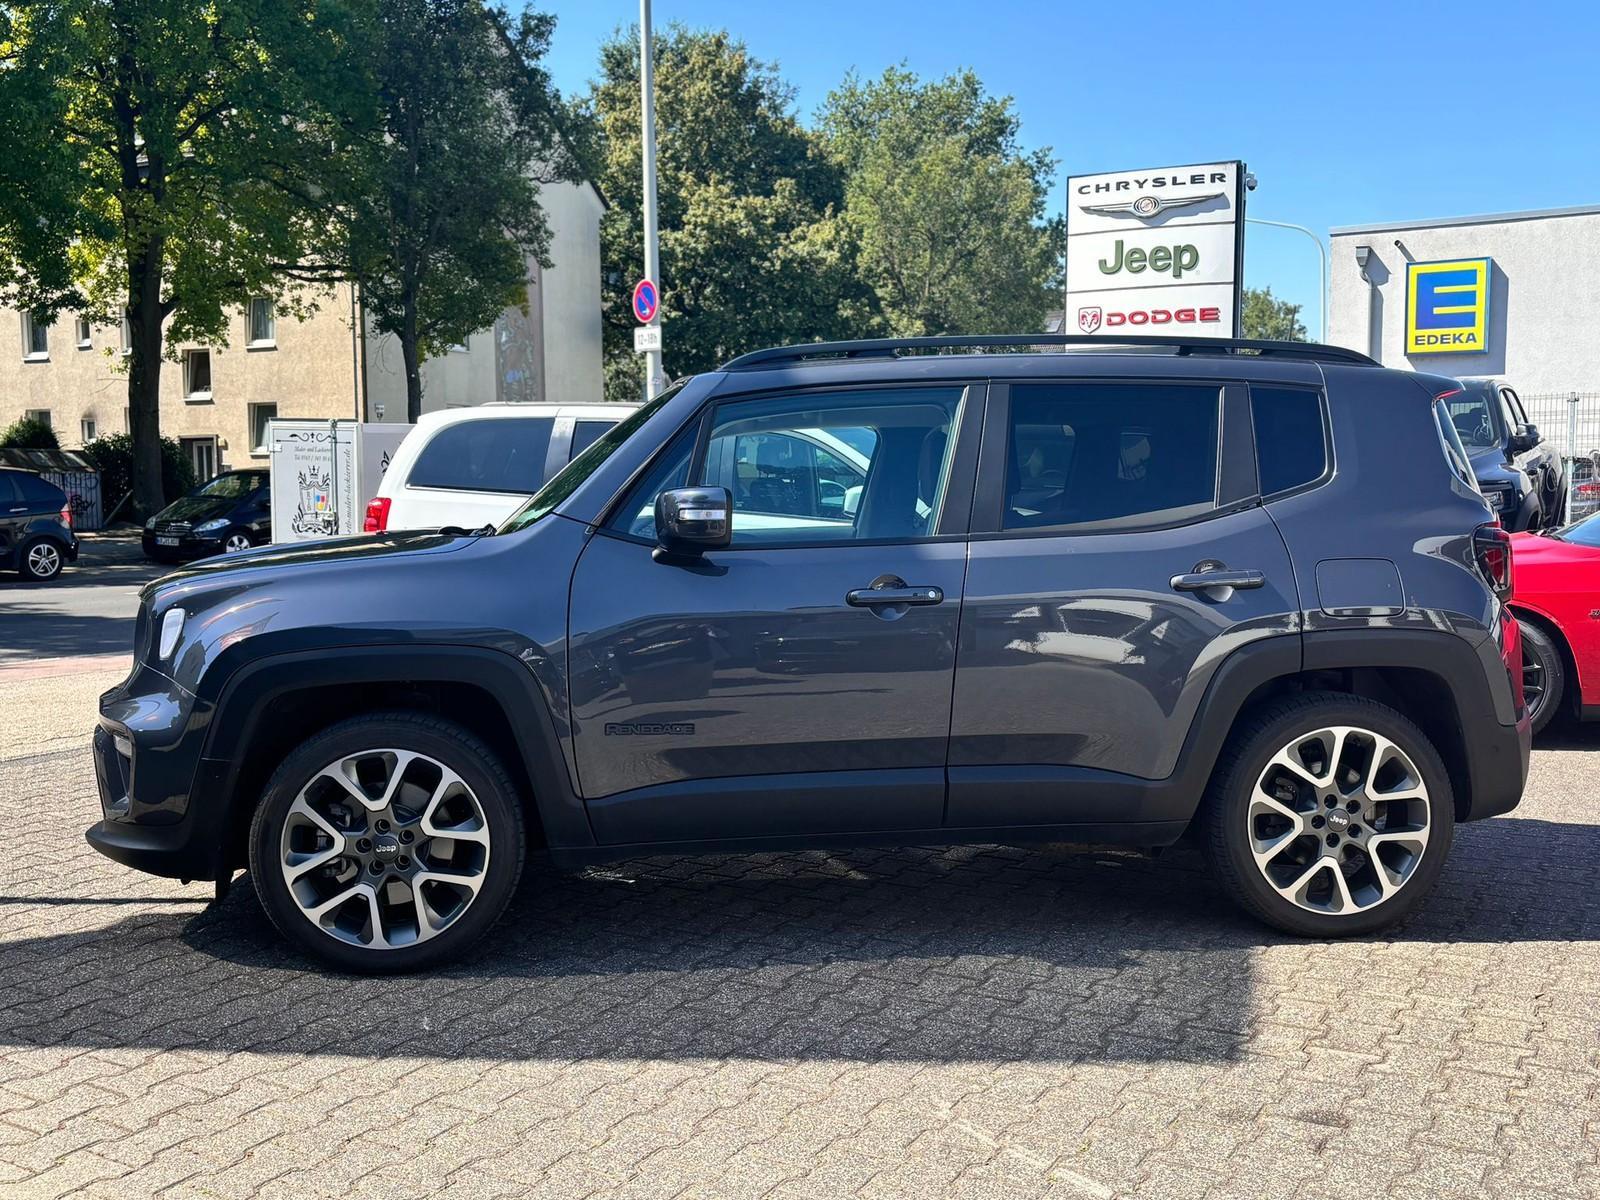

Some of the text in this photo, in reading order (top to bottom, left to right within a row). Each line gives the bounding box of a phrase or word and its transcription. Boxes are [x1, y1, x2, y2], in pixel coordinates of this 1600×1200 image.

[1077, 172, 1227, 195] CHRYSLER
[1098, 239, 1200, 279] Jeep
[1106, 307, 1221, 327] DODGE
[1414, 332, 1478, 346] EDEKA
[604, 722, 696, 736] RENEGADE
[1330, 815, 1348, 826] Jeep
[375, 844, 397, 853] Jeep
